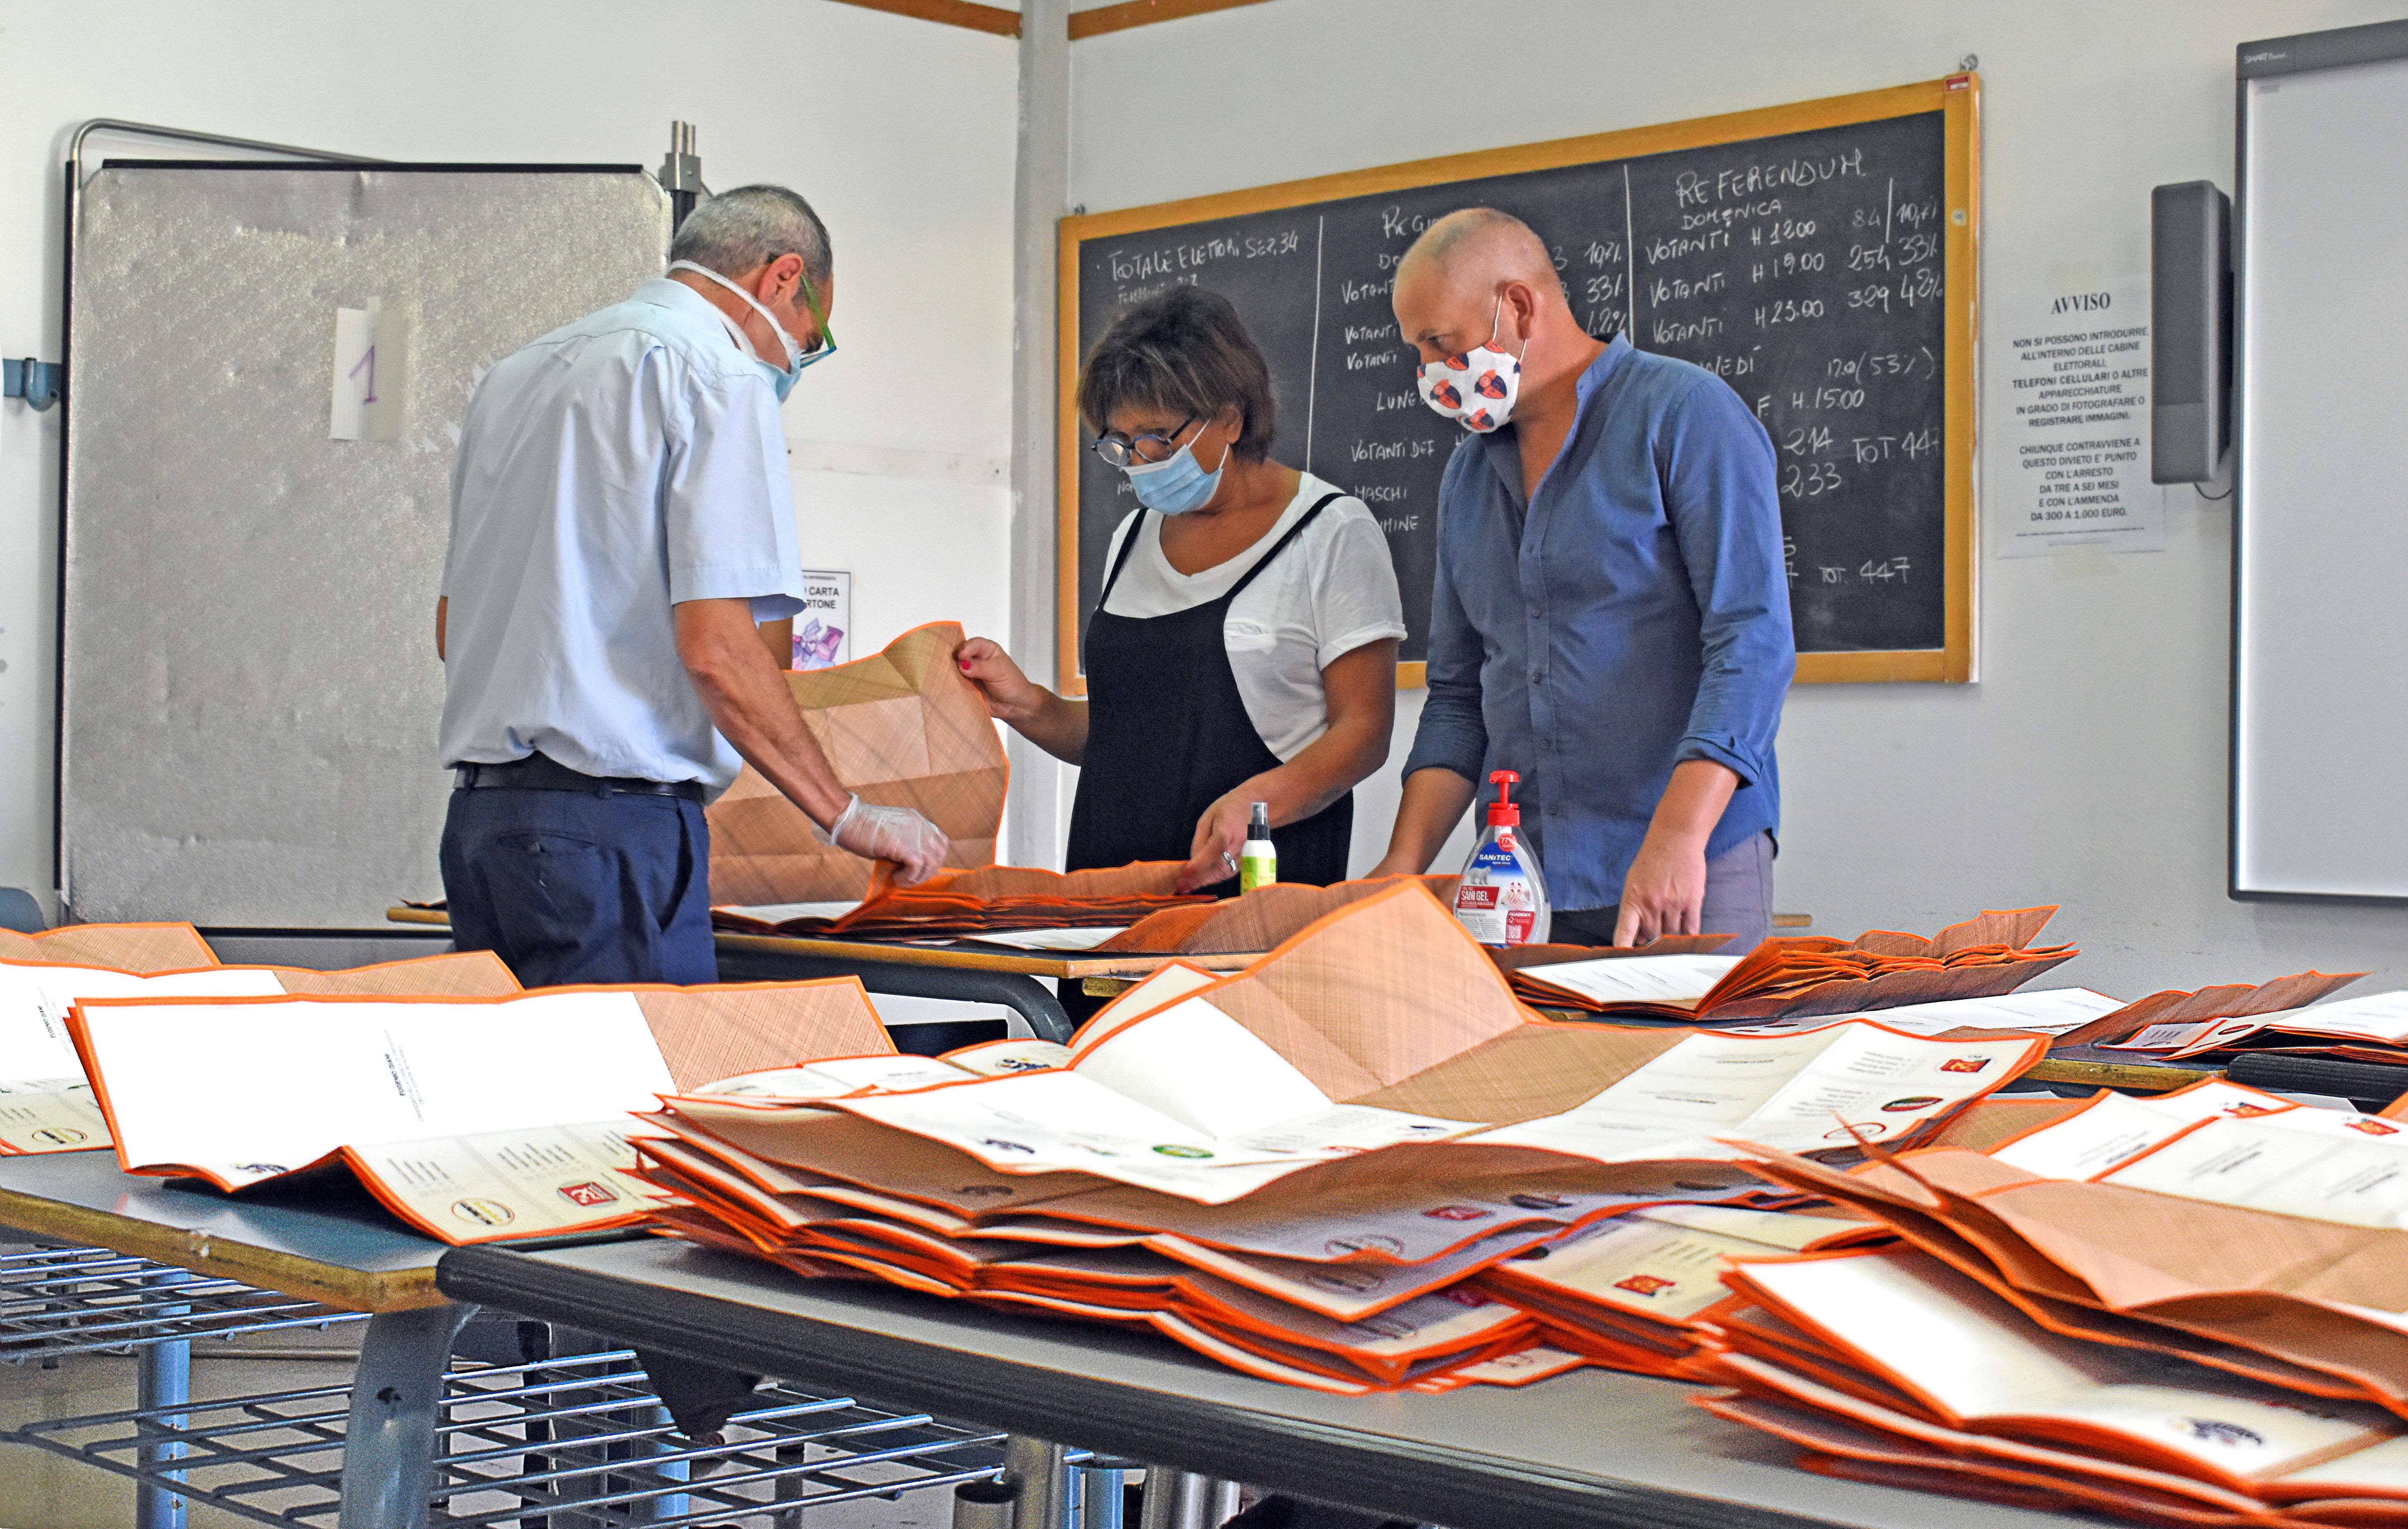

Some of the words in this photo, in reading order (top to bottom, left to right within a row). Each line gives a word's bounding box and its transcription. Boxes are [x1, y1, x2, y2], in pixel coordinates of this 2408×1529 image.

[1681, 199, 1782, 230] DOMENICA
[1646, 226, 1730, 265] VOTANTI
[1752, 227, 1761, 246] H
[1848, 246, 1890, 272] 254
[1108, 250, 1172, 281] TOTALE
[1341, 275, 1393, 304] VOTANT
[1650, 272, 1725, 308] VOTANTI
[1753, 263, 1763, 283] H
[2051, 292, 2111, 315] AVVISO
[1345, 324, 1396, 345] VOTANTI
[1651, 316, 1723, 344] VOTANTI
[1755, 306, 1766, 329] H
[2012, 339, 2031, 348] NON
[2034, 337, 2043, 347] SI
[2044, 333, 2087, 345] POSSONO
[1347, 350, 1397, 370] VOTANTI
[2021, 348, 2076, 361] ALL'INTERNO
[2078, 345, 2105, 355] DELLE
[2107, 341, 2140, 353] CABINE
[348, 345, 377, 406] 1
[2012, 376, 2057, 389] TELEFONI
[2059, 371, 2110, 385] CELLULARI
[2112, 371, 2118, 380] O
[2121, 368, 2148, 379] ALTRE
[2038, 384, 2122, 399] APPARECCHIATURE
[2016, 406, 2025, 415] IN
[2027, 403, 2059, 414] GRADO
[2061, 402, 2070, 411] DI
[2072, 396, 2135, 410] FOTOGRAFARE
[2138, 396, 2145, 405] O
[2028, 415, 2083, 428] REGISTRARE
[1351, 438, 1407, 462] VOTANTI
[2020, 443, 2064, 455] CHIUNQUE
[2066, 438, 2132, 451] CONTRAVVIENE
[2134, 438, 2140, 446] A
[2022, 457, 2057, 469] QUESTO
[2059, 455, 2092, 466] DIVIETO
[2105, 452, 2137, 462] PUNITO
[1781, 462, 1842, 498] 233
[2045, 471, 2064, 480] CON
[2066, 467, 2113, 478] L'ARRESTO
[1355, 485, 1407, 502] MASCHI
[2039, 485, 2052, 494] DA
[2054, 484, 2071, 492] TRE
[2073, 483, 2080, 491] A
[2081, 482, 2095, 491] SEI
[2098, 480, 2119, 489] MESI
[2039, 499, 2044, 507] E
[2046, 498, 2066, 506] CON
[2067, 494, 2119, 505] L'AMMENDA
[2030, 512, 2043, 521] DA
[2045, 511, 2063, 520] 300
[2065, 511, 2071, 519] A
[1860, 556, 1911, 584] 447
[809, 586, 840, 597] CARTA
[806, 599, 836, 609] RTONE
[1461, 890, 1475, 901] SANI
[1476, 891, 1489, 901] GEL
